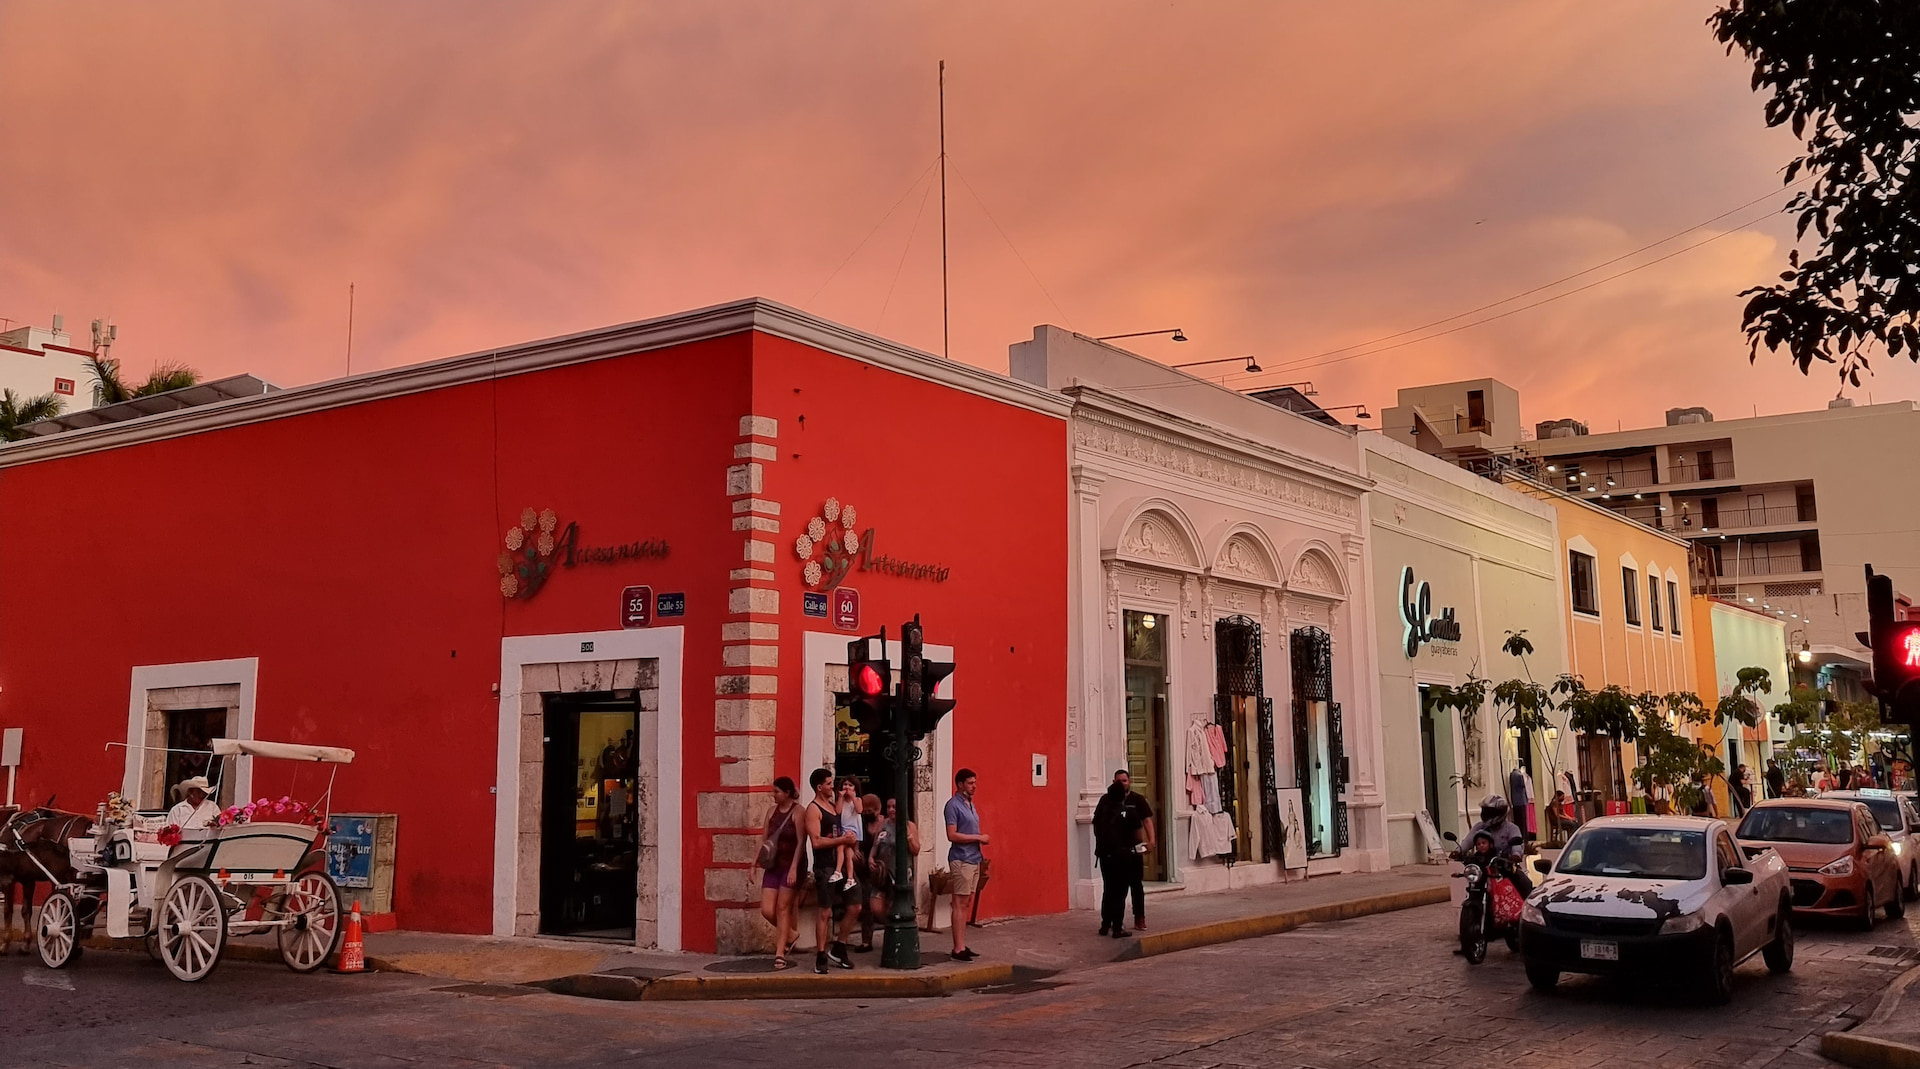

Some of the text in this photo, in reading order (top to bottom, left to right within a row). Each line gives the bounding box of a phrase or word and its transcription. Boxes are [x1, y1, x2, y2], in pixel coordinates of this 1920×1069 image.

[629, 598, 643, 612] 55
[658, 600, 684, 611] Calle 55
[804, 600, 827, 611] Calle 60
[841, 600, 853, 613] 60
[1430, 643, 1458, 657] guayaberas
